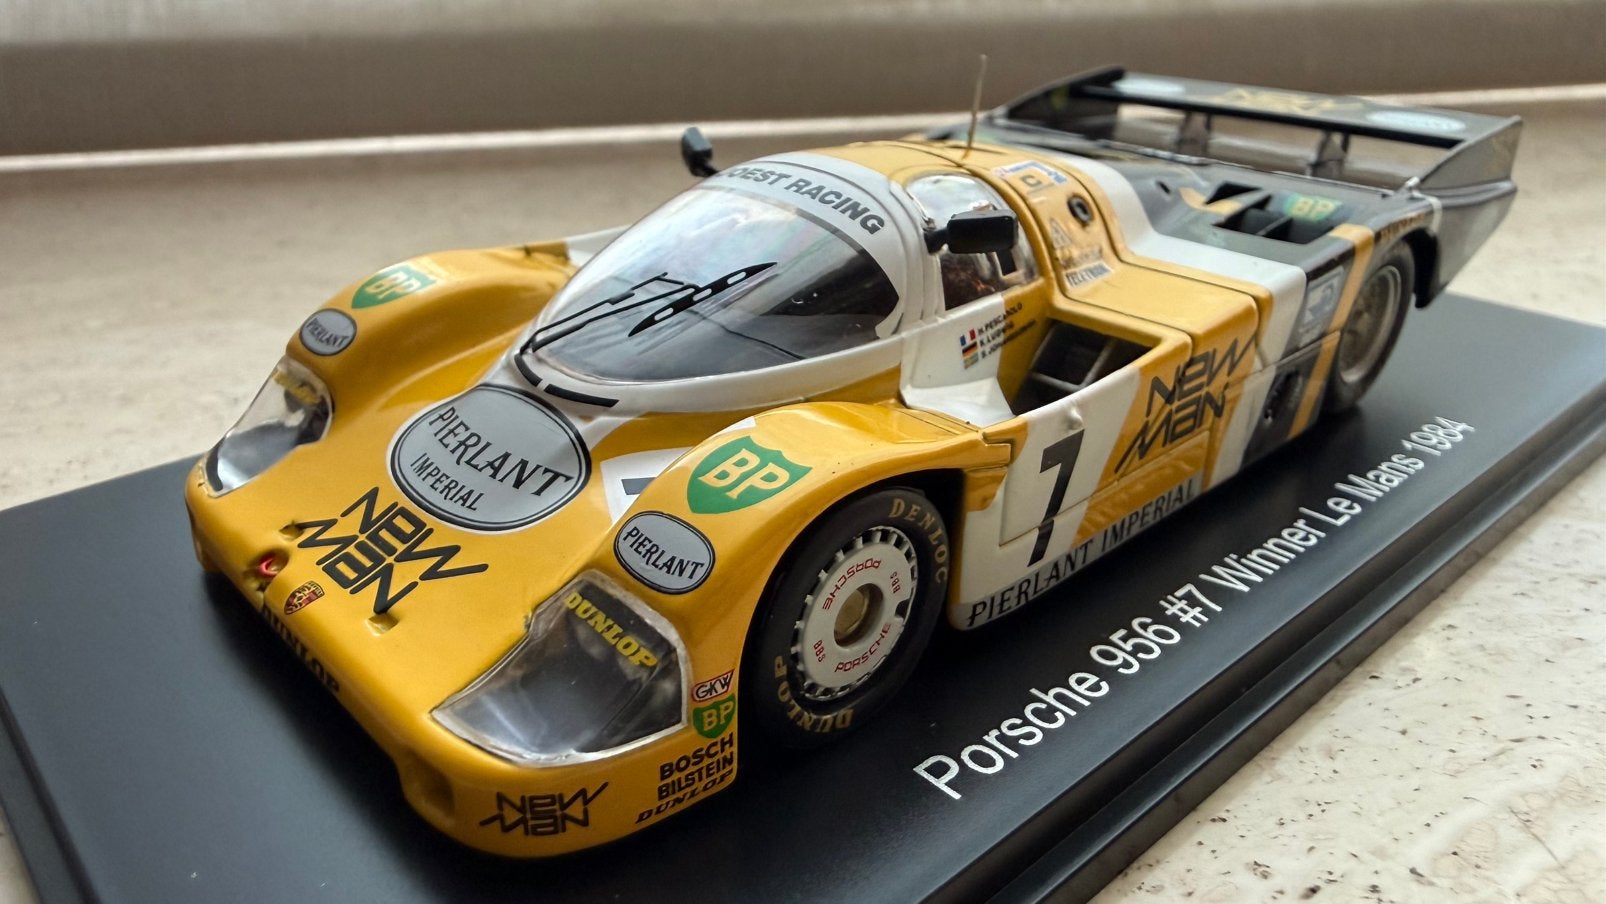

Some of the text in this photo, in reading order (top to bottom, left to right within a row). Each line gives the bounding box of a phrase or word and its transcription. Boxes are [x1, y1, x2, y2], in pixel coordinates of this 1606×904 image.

[783, 177, 886, 235] RACING
[365, 270, 417, 299] BP
[306, 317, 350, 349] PIERLANT
[428, 406, 573, 496] PIERLANT
[698, 447, 790, 499] BP
[411, 452, 486, 512] IMPERIAL
[1027, 428, 1086, 568] 7
[622, 526, 704, 580] PIERLANT
[888, 498, 949, 584] DENLOC
[967, 478, 1196, 628] PIERLANT IMPERIAL
[822, 557, 882, 611] PORSCHE
[912, 415, 1476, 800] Porsche 956 #7 Winner Le Mans 1984
[563, 591, 658, 668] DUNLOP
[834, 622, 892, 673] PORSCHE
[702, 700, 734, 731] BP
[773, 655, 856, 734] DUNLOP
[657, 751, 734, 801] BILSTEIN
[659, 732, 734, 782] BOSCH
[635, 767, 734, 824] DUNLOP
